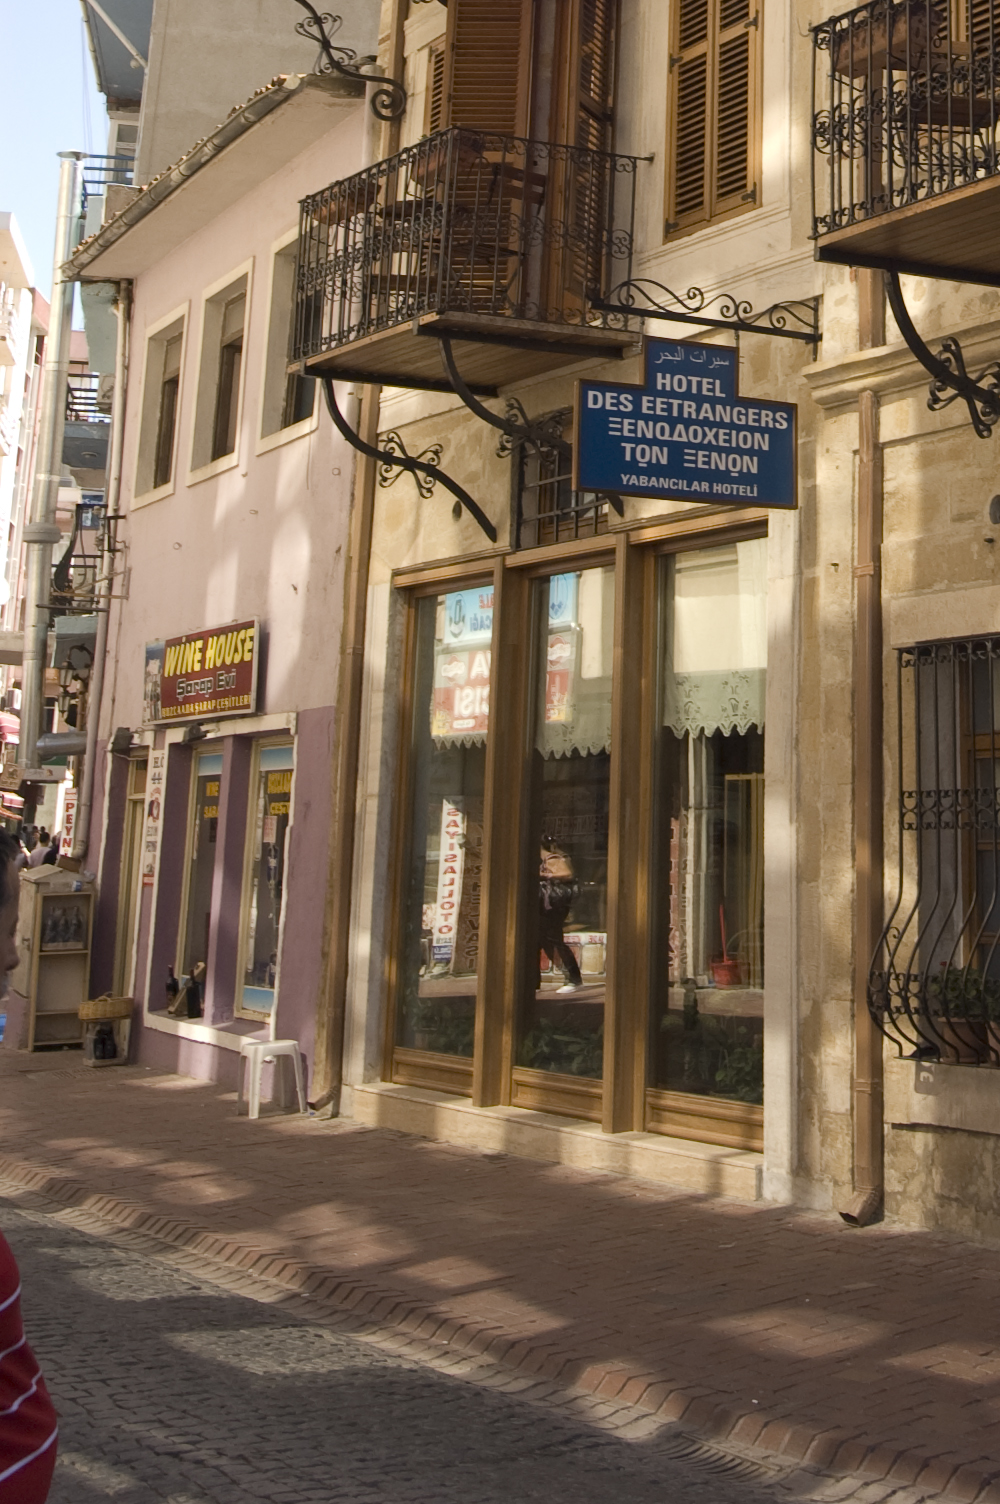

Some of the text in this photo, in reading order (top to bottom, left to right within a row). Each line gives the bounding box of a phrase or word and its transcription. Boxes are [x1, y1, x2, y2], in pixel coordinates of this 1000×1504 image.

[656, 372, 726, 397] HOTEL
[587, 390, 788, 430] DES EETRANGERS
[620, 473, 758, 497] YABANCILAR HOTELİ
[205, 627, 255, 669] HOUSE
[176, 668, 237, 702] Şarap Evi
[62, 802, 76, 857] PEYN
